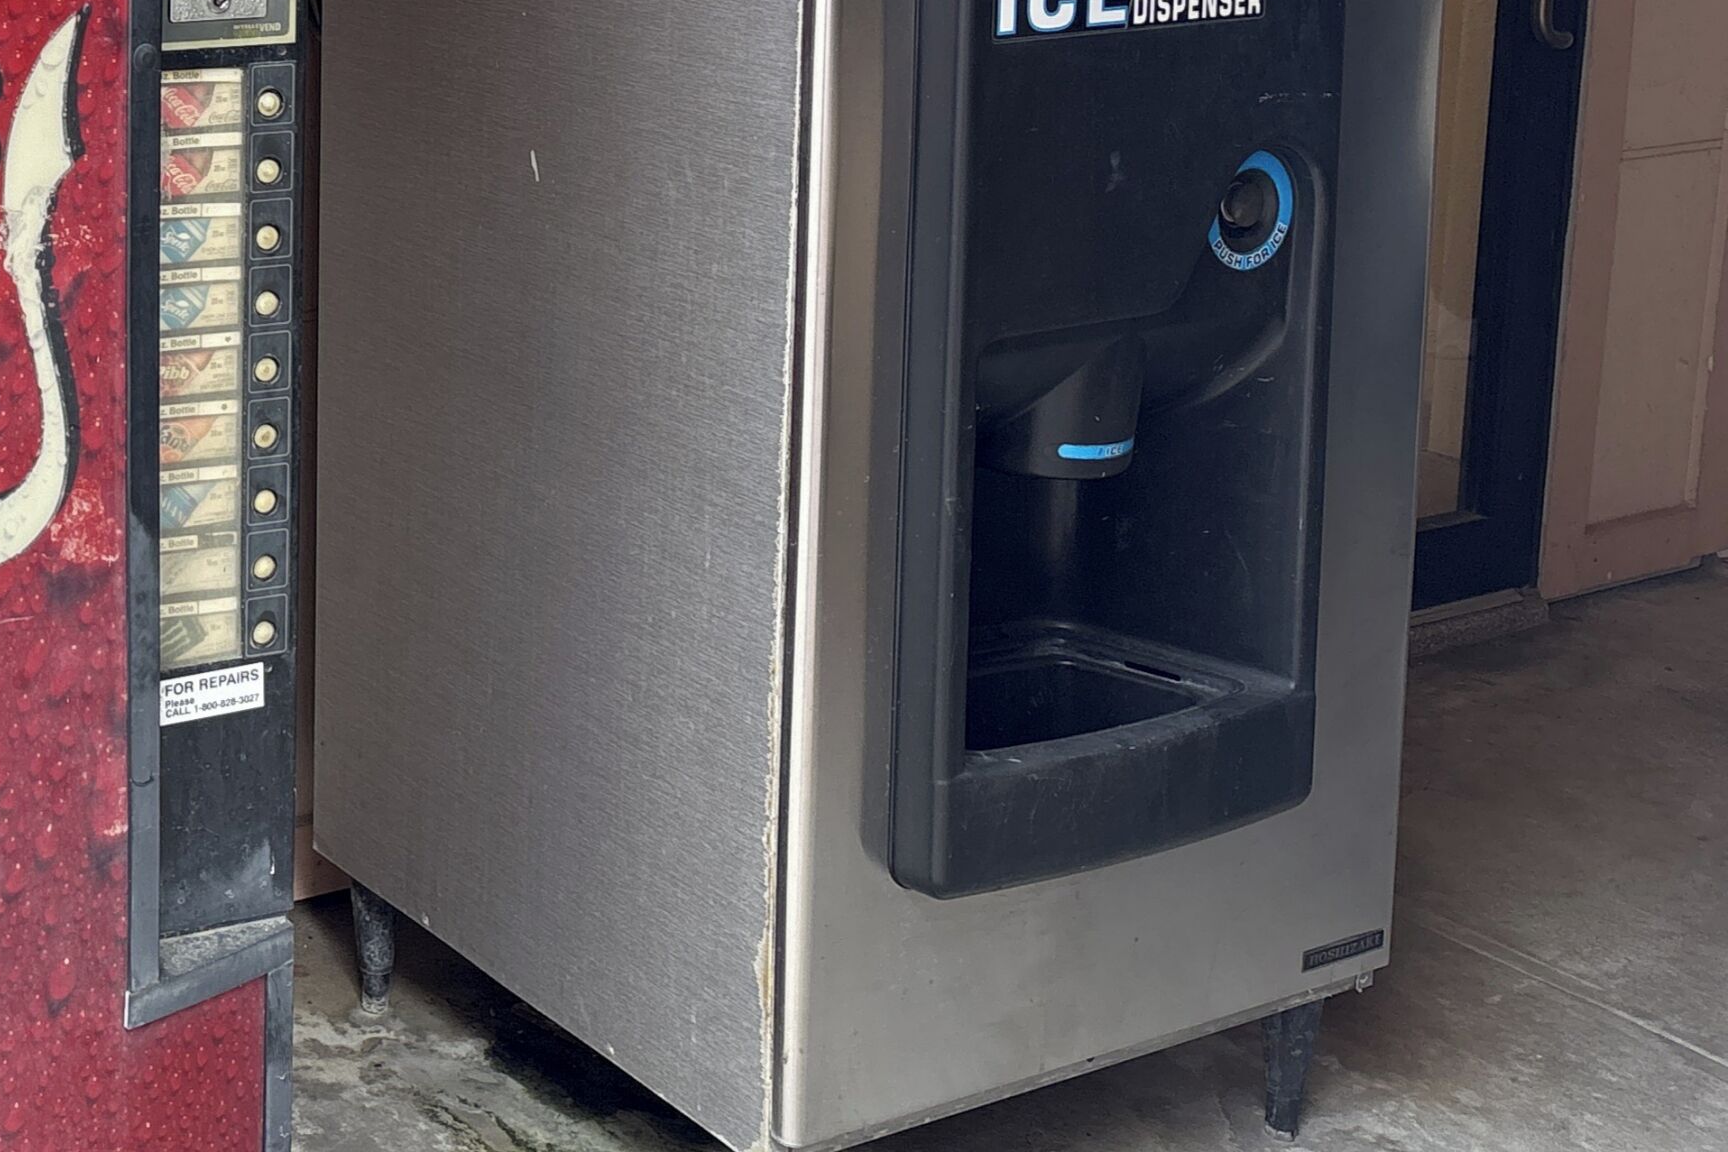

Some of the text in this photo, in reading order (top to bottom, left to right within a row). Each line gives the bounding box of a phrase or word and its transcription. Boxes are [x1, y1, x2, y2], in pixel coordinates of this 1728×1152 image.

[173, 137, 200, 146] Bottle
[171, 207, 198, 215] Bottle
[1214, 224, 1287, 267] PUSH FOR ICE
[171, 272, 198, 280] Bottle
[170, 339, 196, 348] Bottle
[169, 407, 196, 415] Bottle
[164, 669, 259, 697] FOR REPAIRS
[165, 698, 195, 708] Please
[165, 706, 191, 718] CALL
